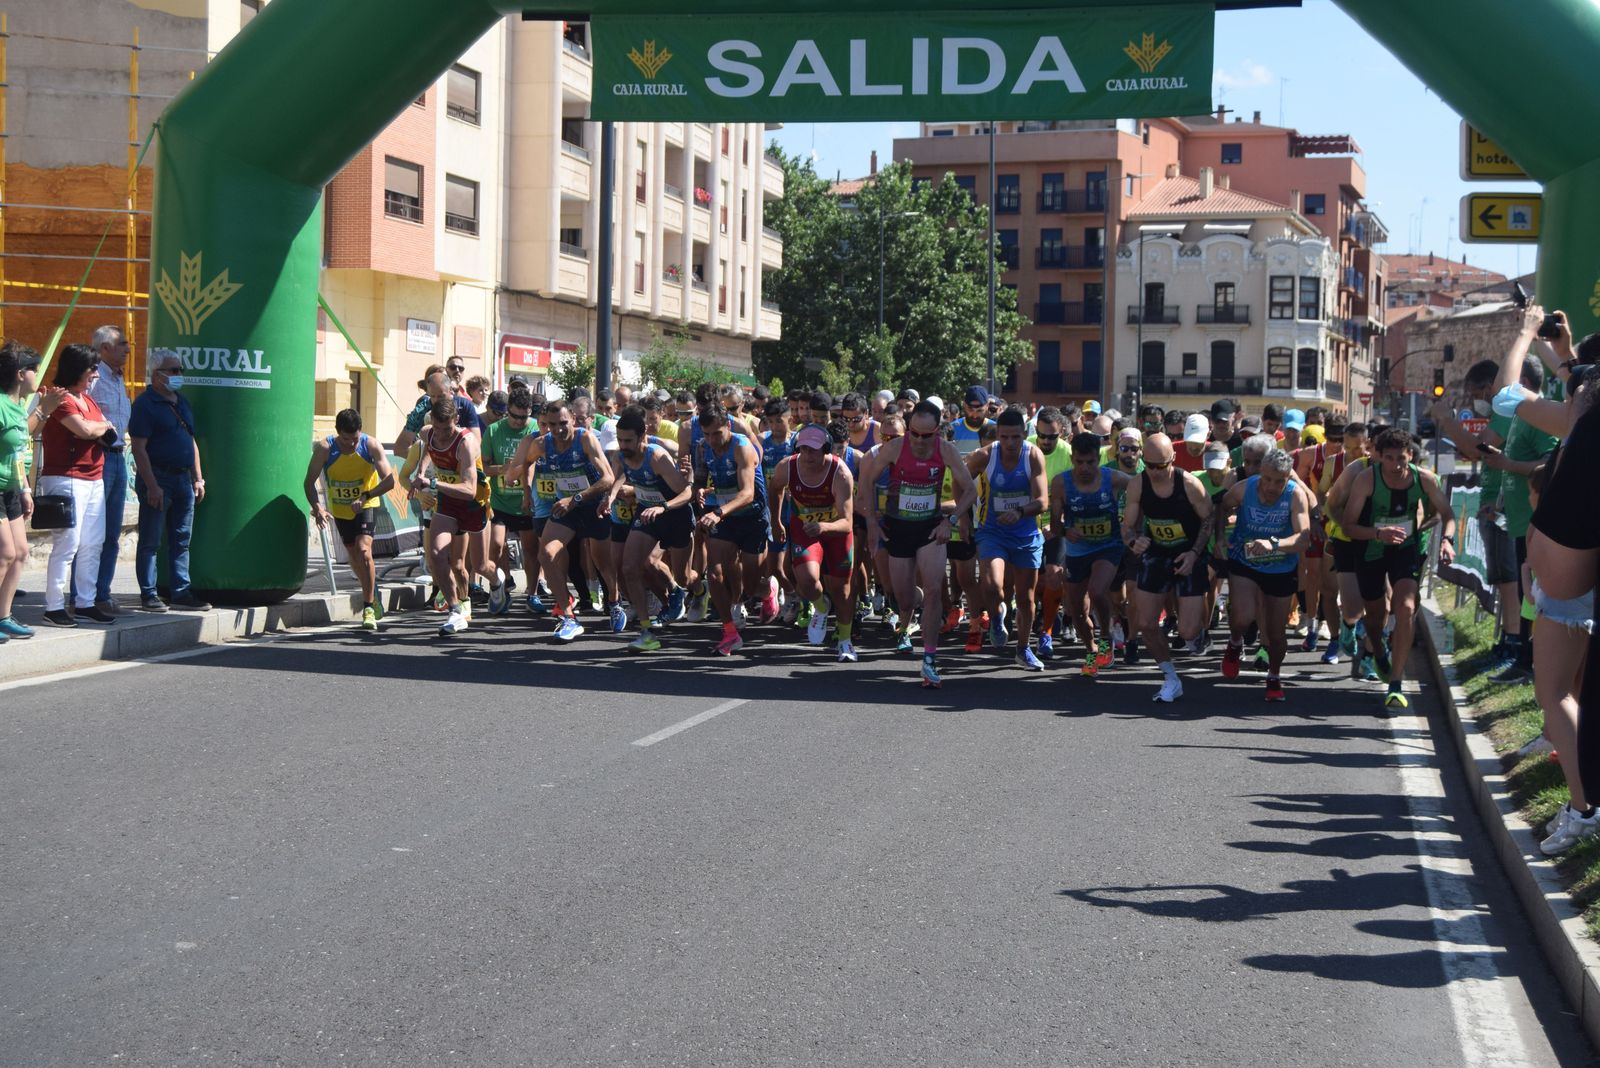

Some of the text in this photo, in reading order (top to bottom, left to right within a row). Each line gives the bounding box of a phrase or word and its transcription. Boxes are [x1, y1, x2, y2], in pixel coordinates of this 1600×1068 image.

[705, 36, 1086, 97] SALIDA
[612, 83, 688, 96] CAJA RURAL
[1105, 76, 1188, 91] CAJA RURAL
[175, 346, 271, 374] RURAL
[335, 487, 361, 500] 139
[1080, 524, 1105, 535] 113
[1155, 526, 1175, 539] 49
